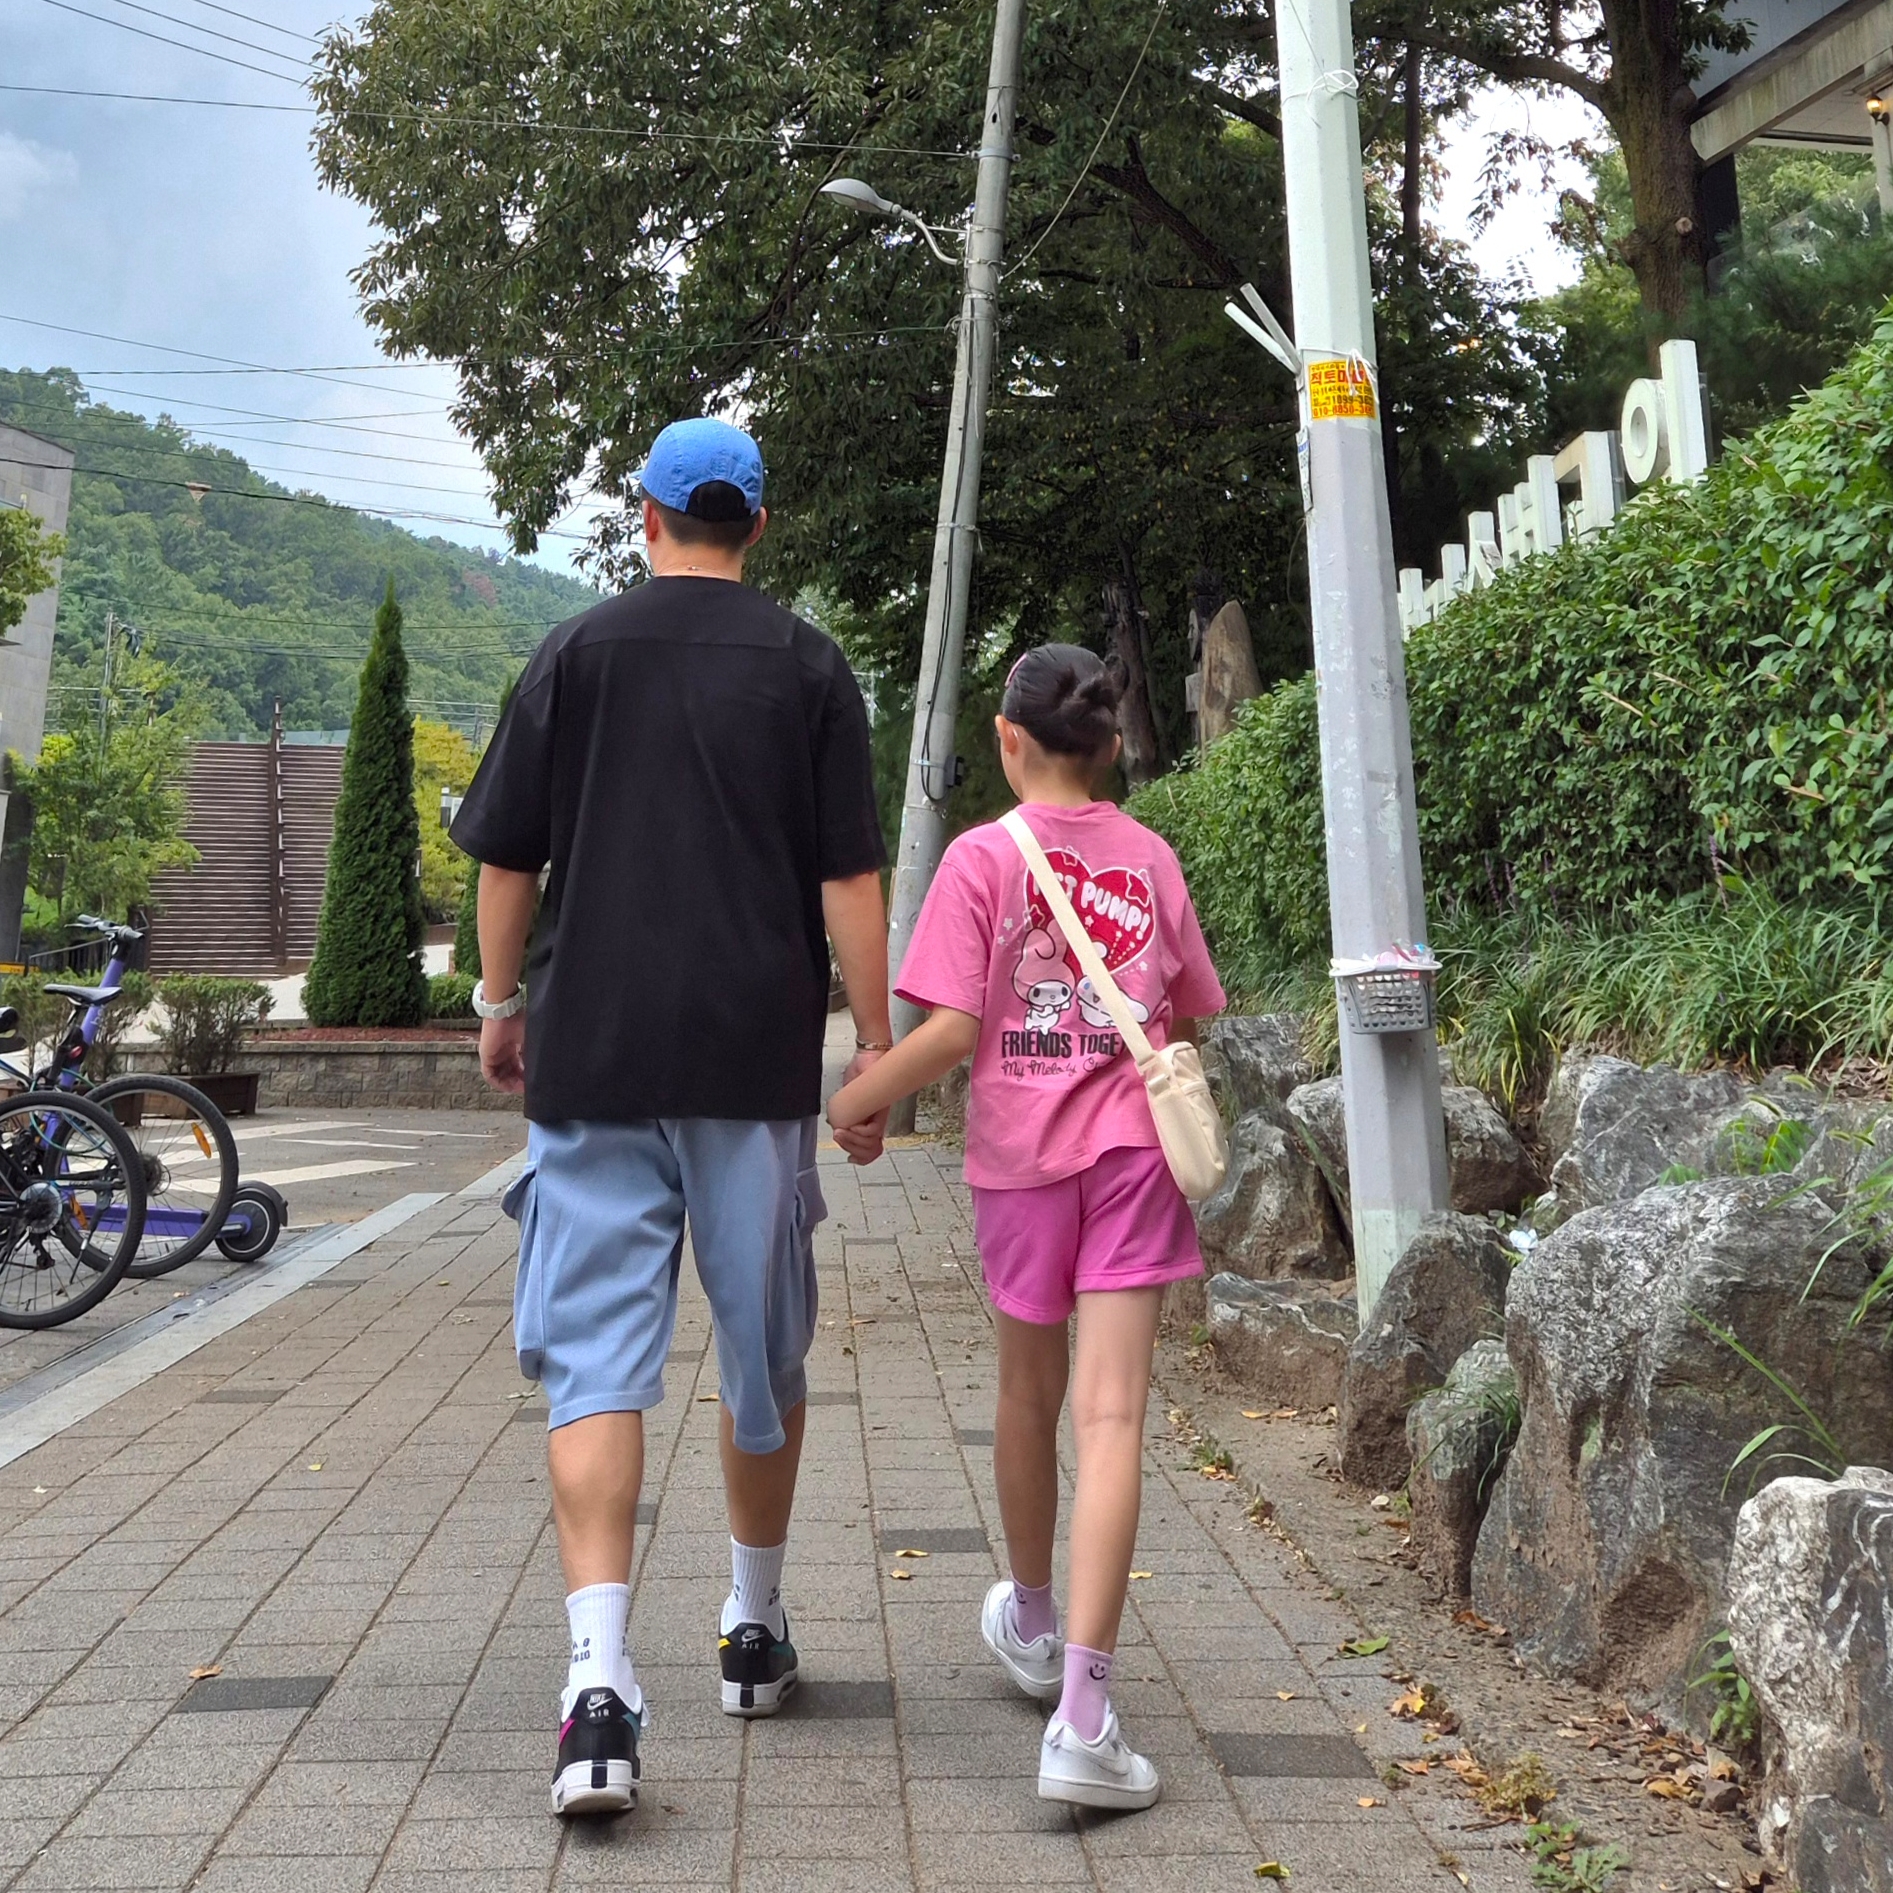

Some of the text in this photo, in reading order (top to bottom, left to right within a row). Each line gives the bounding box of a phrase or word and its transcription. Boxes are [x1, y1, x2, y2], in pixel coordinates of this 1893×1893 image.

[1081, 880, 1151, 940] PUMP!
[1001, 1030, 1120, 1059] FRIENDS TOGE
[1001, 1060, 1025, 1081] My
[1027, 1060, 1077, 1077] Melody
[741, 1642, 760, 1650] AIR
[589, 1708, 610, 1718] AIR
